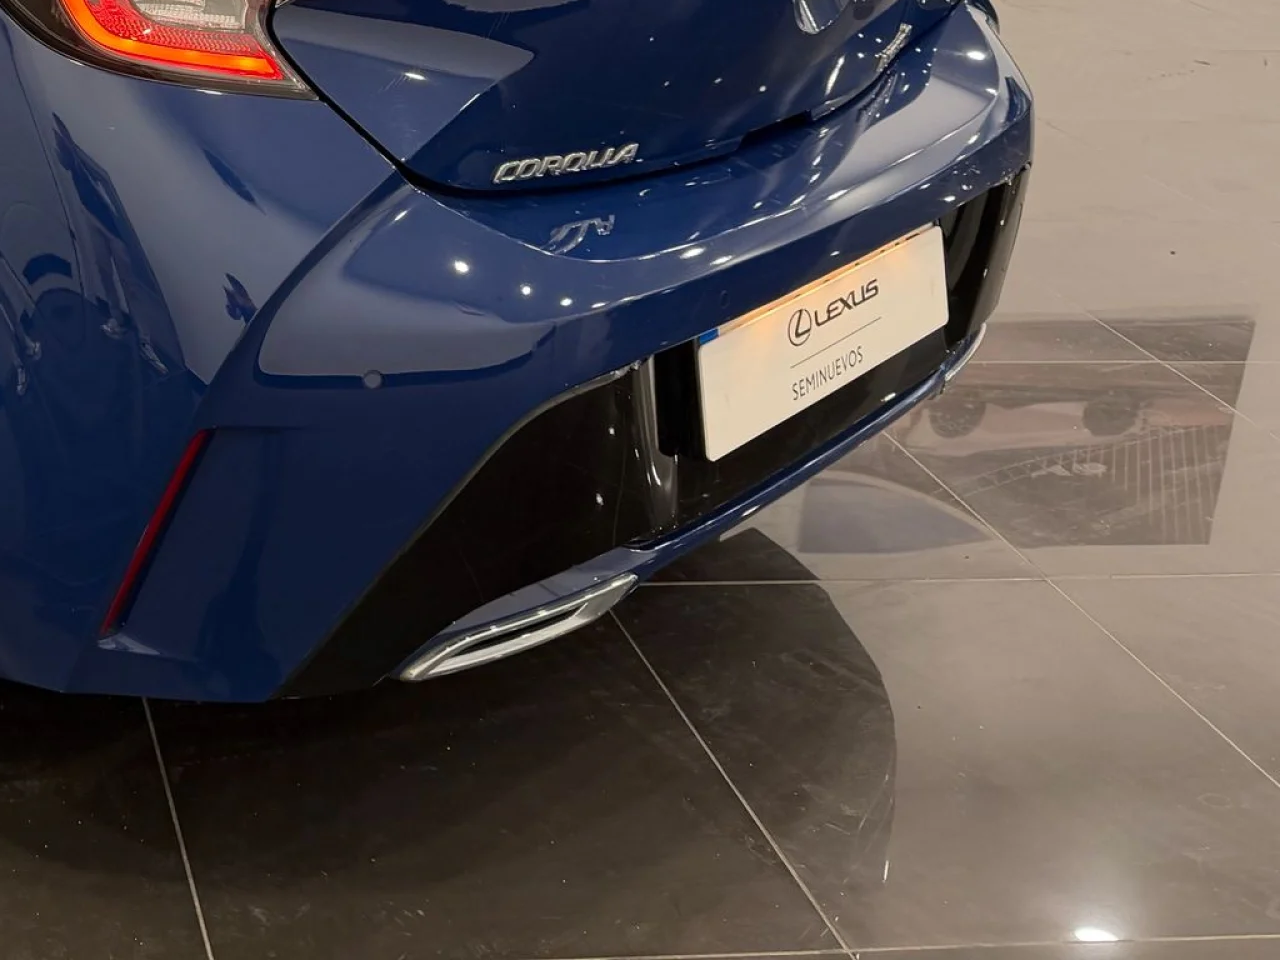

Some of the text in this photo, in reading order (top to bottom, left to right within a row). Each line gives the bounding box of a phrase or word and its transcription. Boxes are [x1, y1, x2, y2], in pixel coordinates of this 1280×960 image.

[492, 143, 639, 184] COROLLA
[814, 278, 879, 327] LEXUS
[791, 346, 864, 401] SEMINUEVOS
